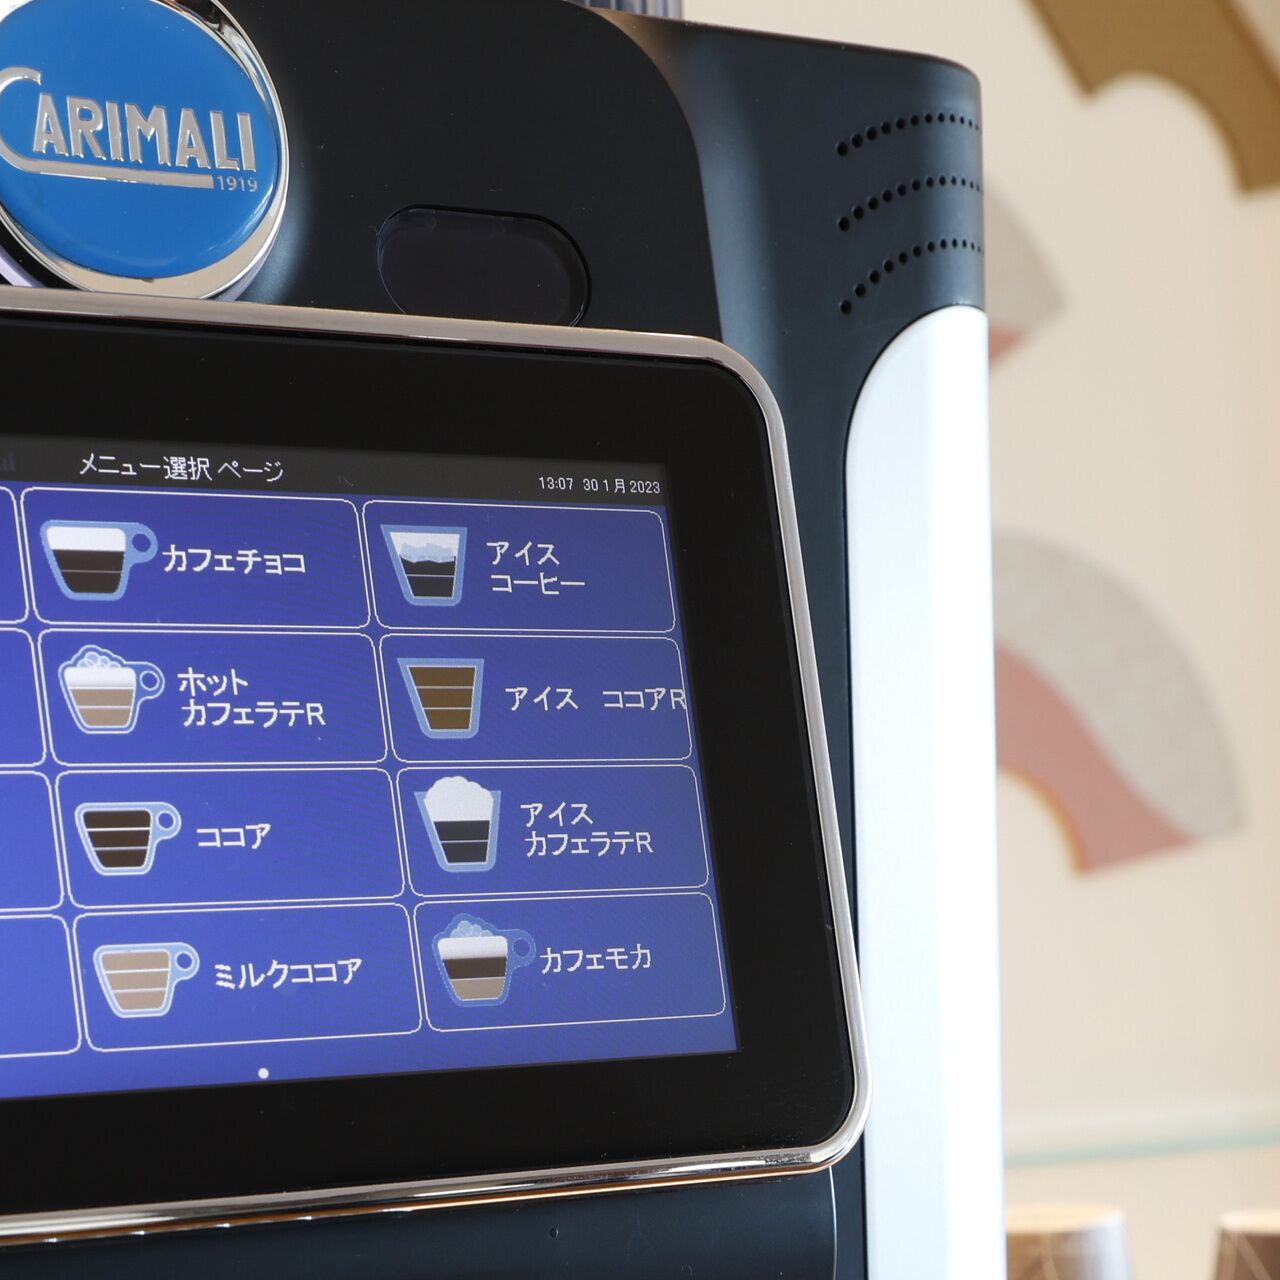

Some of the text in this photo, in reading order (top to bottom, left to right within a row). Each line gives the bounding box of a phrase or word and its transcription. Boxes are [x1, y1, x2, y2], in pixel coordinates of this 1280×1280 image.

[216, 175, 259, 193] 1919
[538, 476, 574, 491] 13:07
[582, 478, 599, 492] 30
[629, 480, 661, 494] 2023
[161, 543, 306, 575] カフェチョコ
[486, 541, 560, 566] アイス
[490, 572, 586, 595] コーヒー
[177, 666, 249, 697] ホット
[504, 685, 686, 712] アイス ココアR
[181, 698, 326, 729] カフェラテR
[520, 801, 594, 828] アイス
[196, 823, 272, 850] ココア
[524, 830, 654, 858] カフェラテR
[539, 943, 651, 975] カフェモカ
[214, 958, 363, 990] ミルクココア
